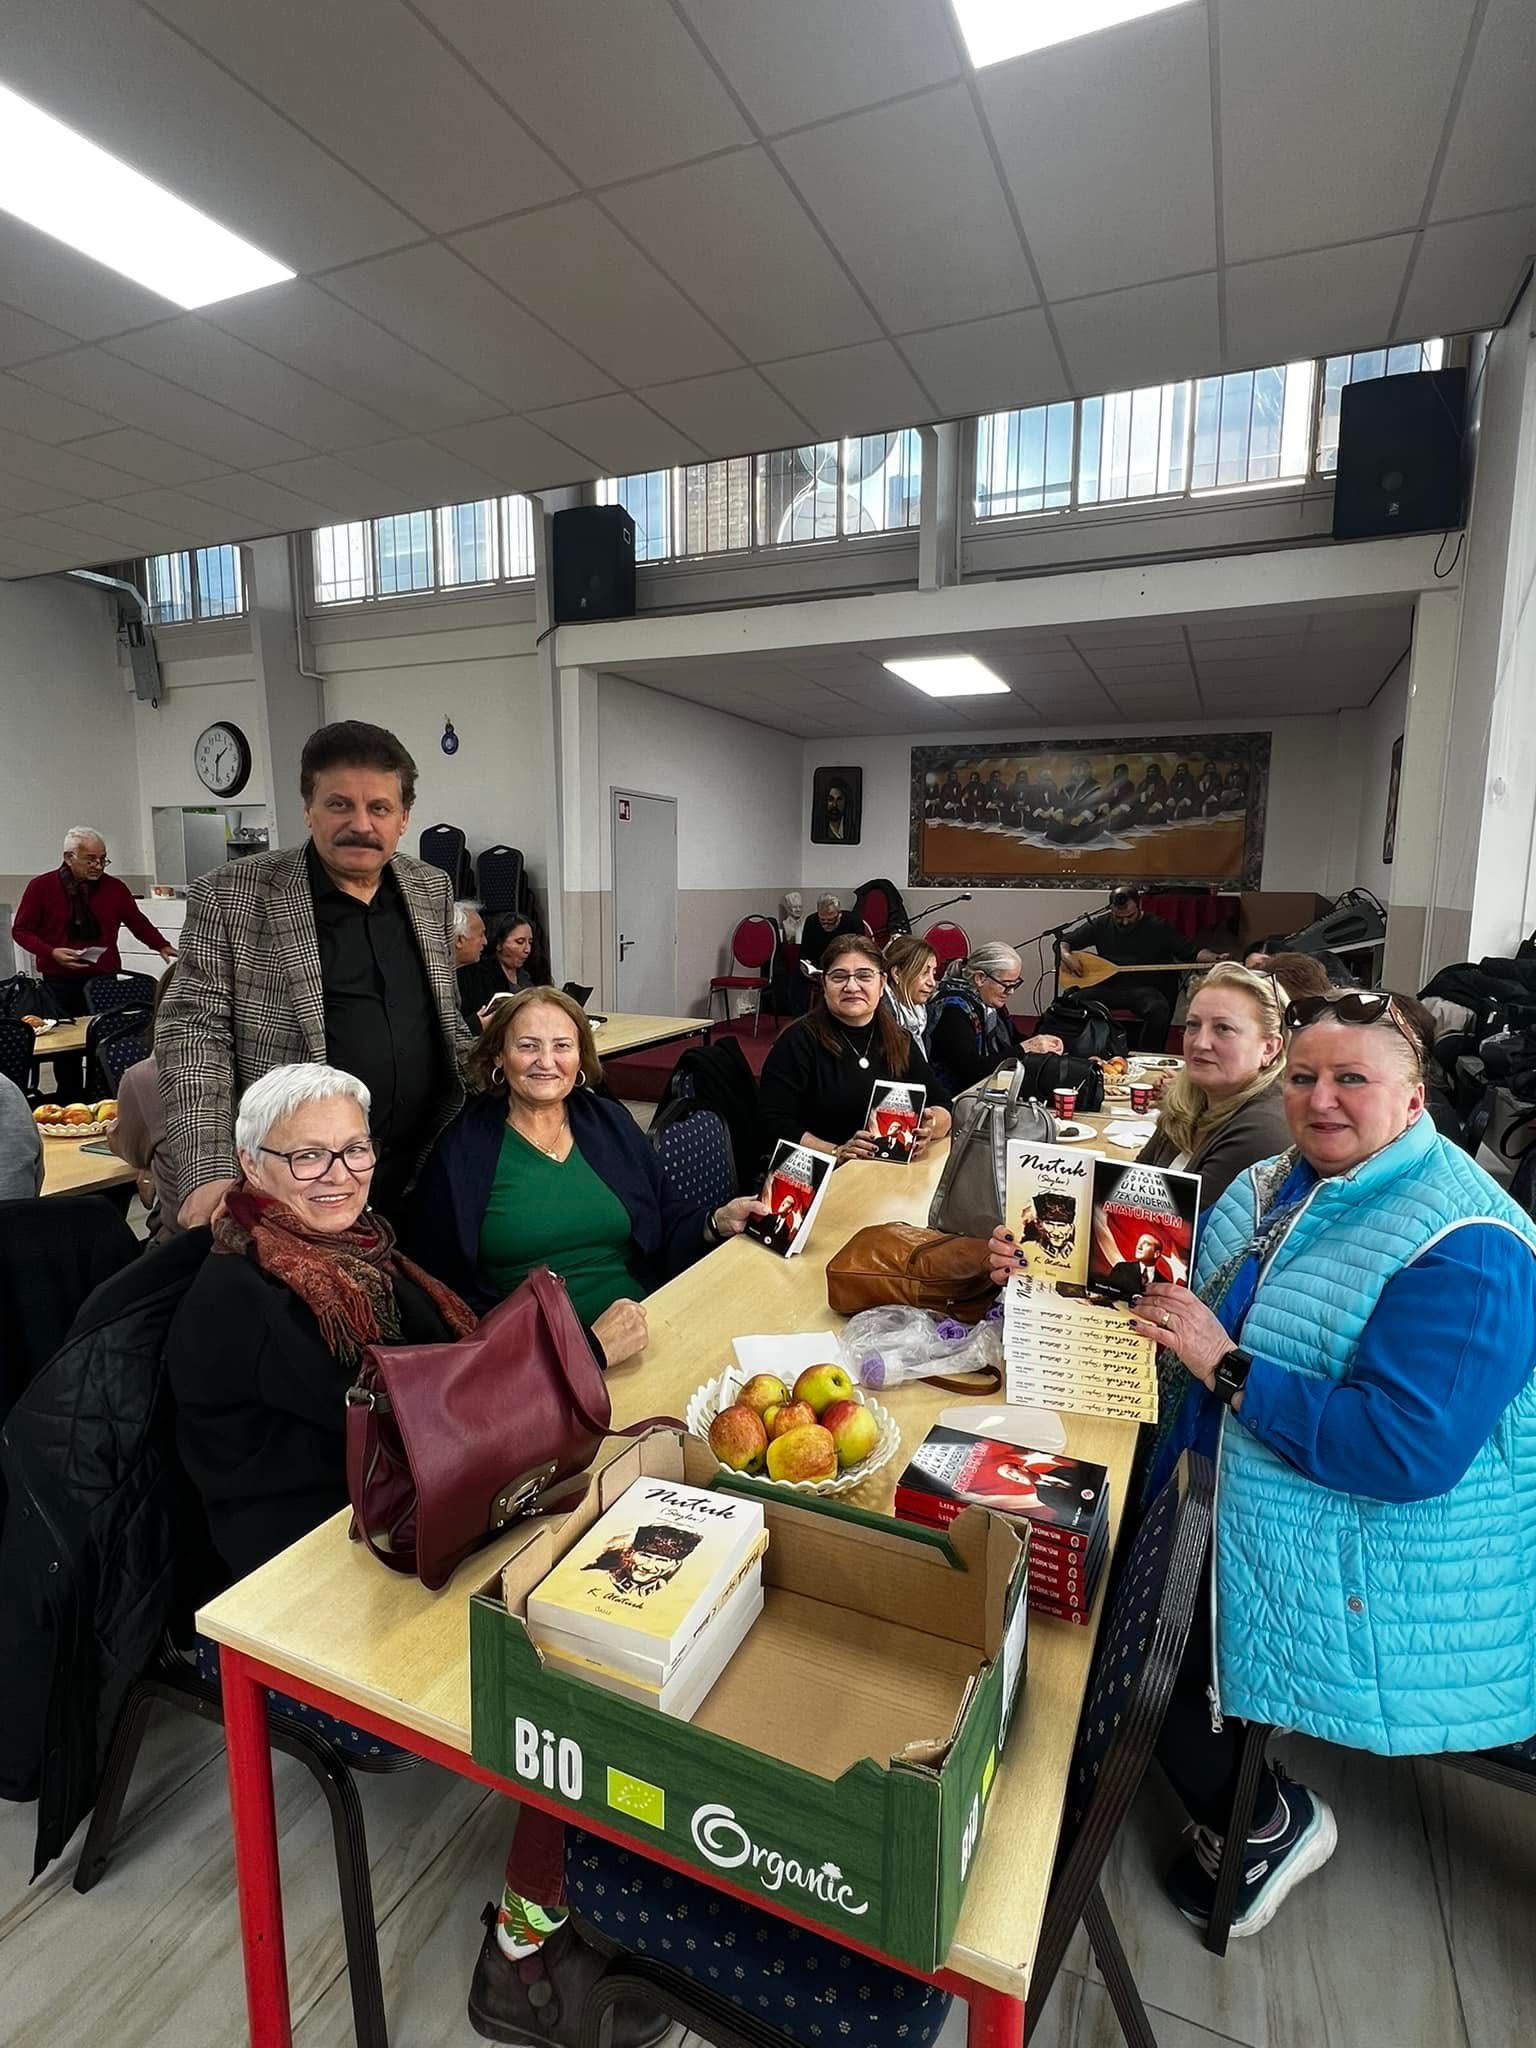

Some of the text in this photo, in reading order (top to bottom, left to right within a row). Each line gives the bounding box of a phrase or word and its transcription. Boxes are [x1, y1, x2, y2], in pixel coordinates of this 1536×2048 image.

[1019, 1154, 1087, 1177] Nutuk
[1114, 1191, 1130, 1201] TEK
[1103, 1200, 1184, 1229] ATATÜRK'ÜM
[644, 1489, 736, 1519] Nutuk
[690, 1802, 869, 1915] Organic
